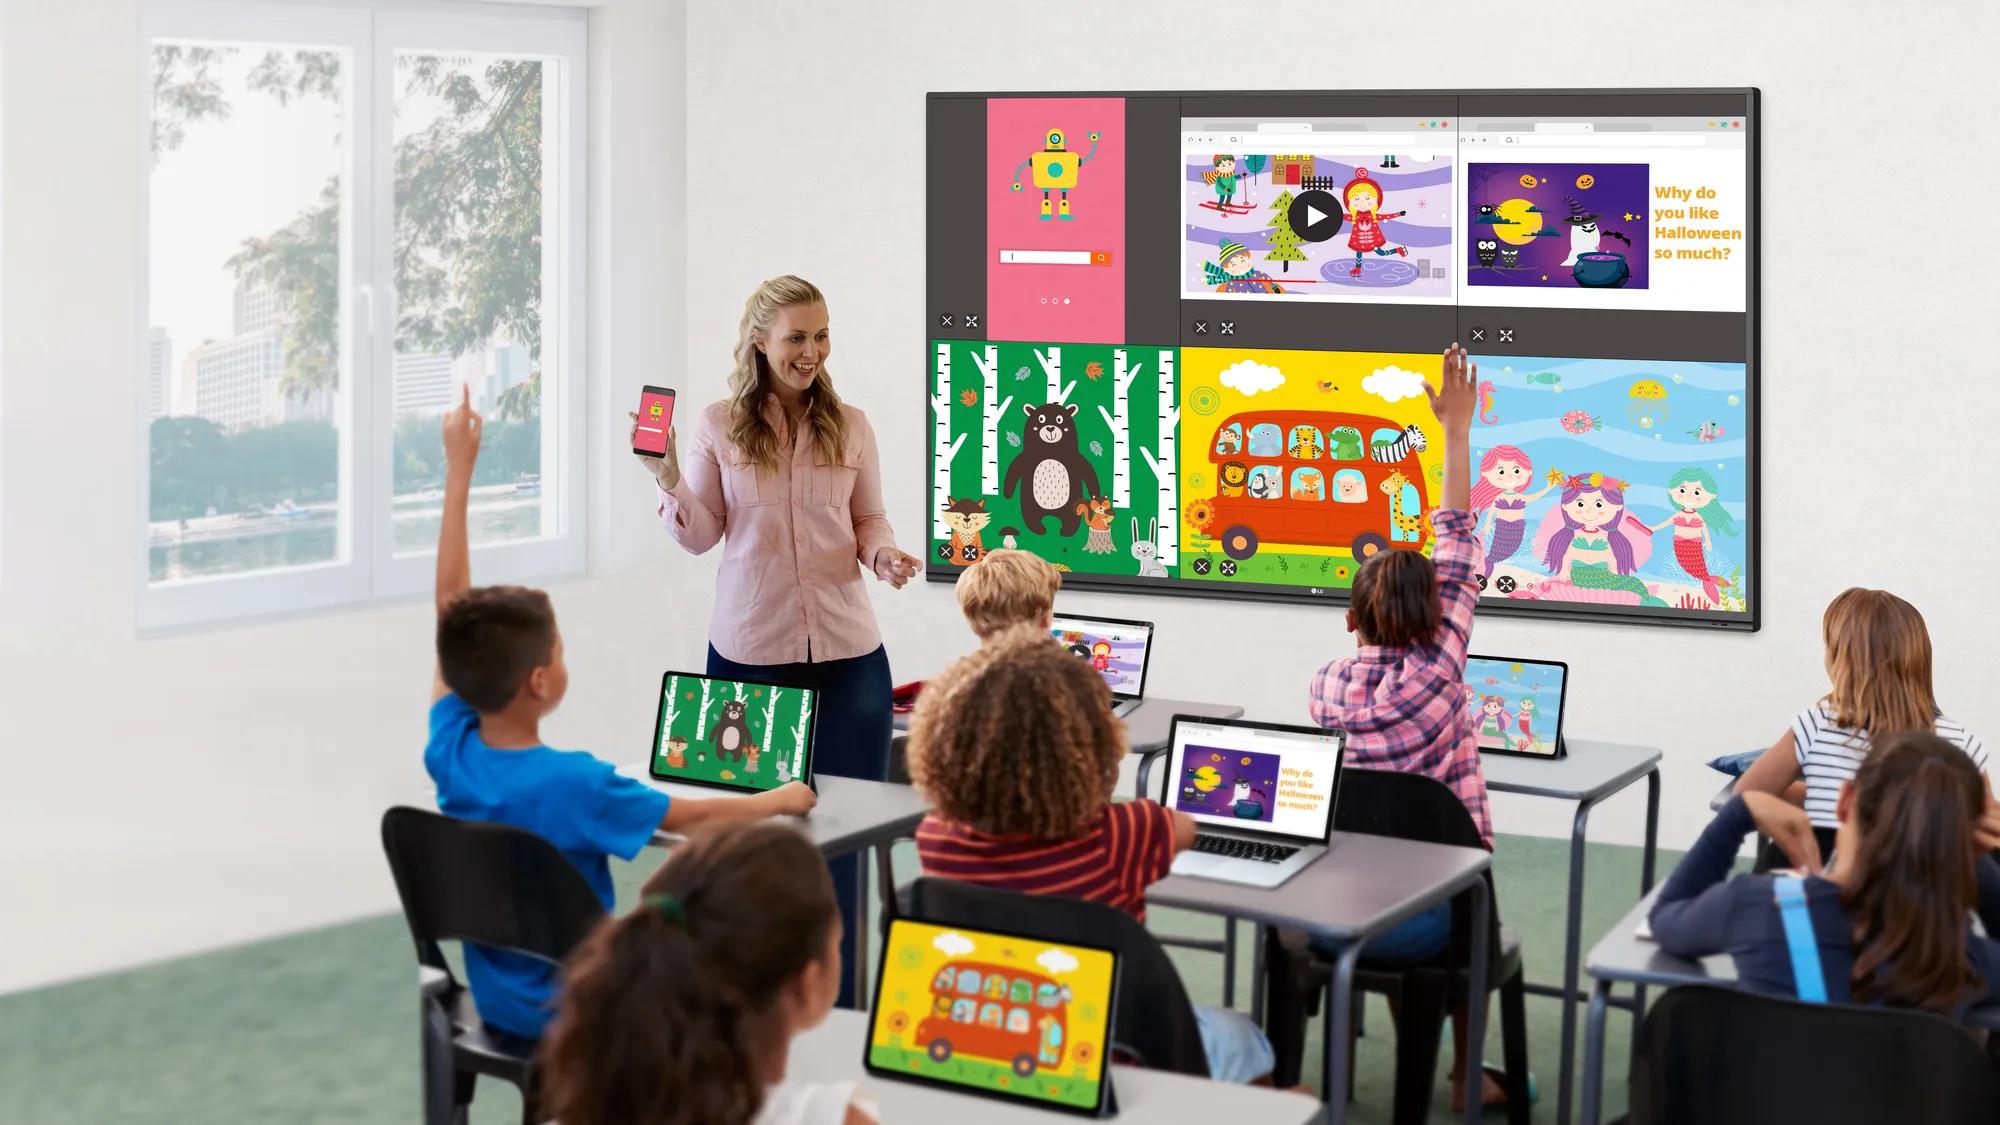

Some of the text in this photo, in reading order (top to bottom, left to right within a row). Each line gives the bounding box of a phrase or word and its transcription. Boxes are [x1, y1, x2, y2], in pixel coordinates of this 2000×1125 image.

[1654, 186, 1716, 202] Why do
[1654, 206, 1719, 222] you like
[1655, 226, 1742, 240] Halloween
[1654, 247, 1731, 260] so much?
[1282, 768, 1300, 778] Why
[1279, 790, 1324, 800] Halloween
